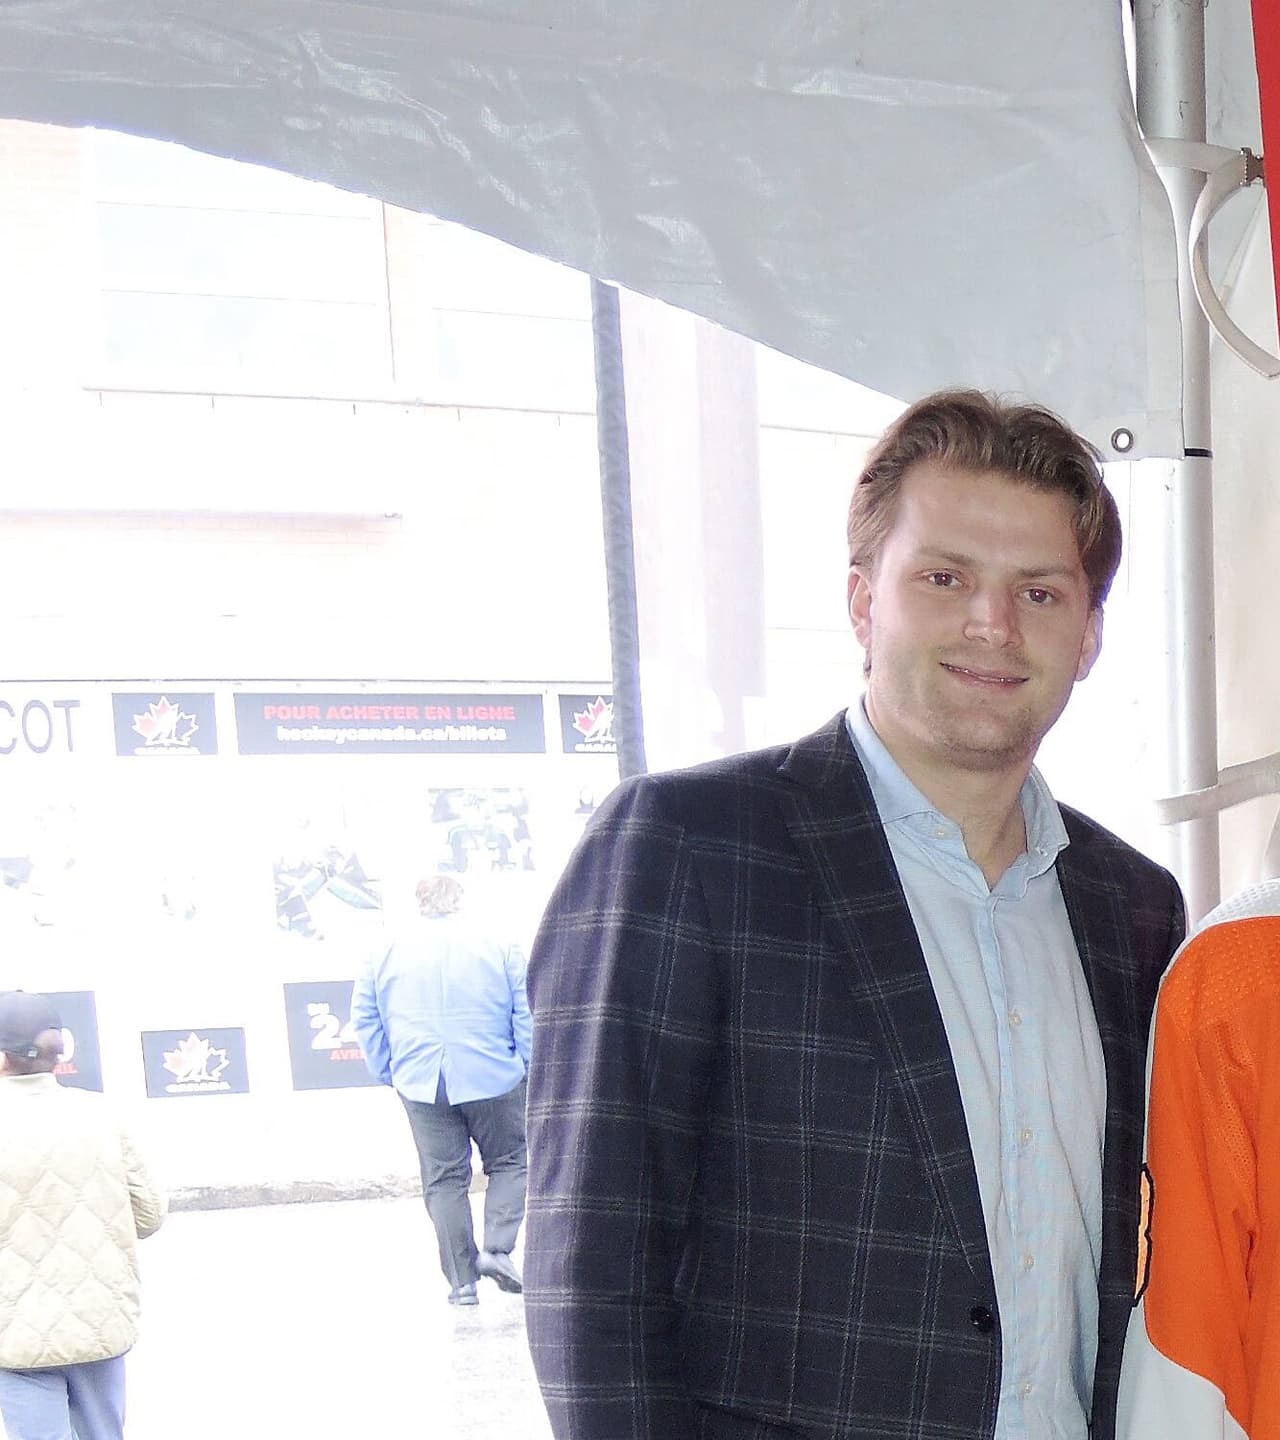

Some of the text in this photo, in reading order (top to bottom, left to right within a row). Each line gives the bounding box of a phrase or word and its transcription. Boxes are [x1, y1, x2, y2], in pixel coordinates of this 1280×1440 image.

[264, 705, 515, 720] POUR ACHETER EN LIGNE
